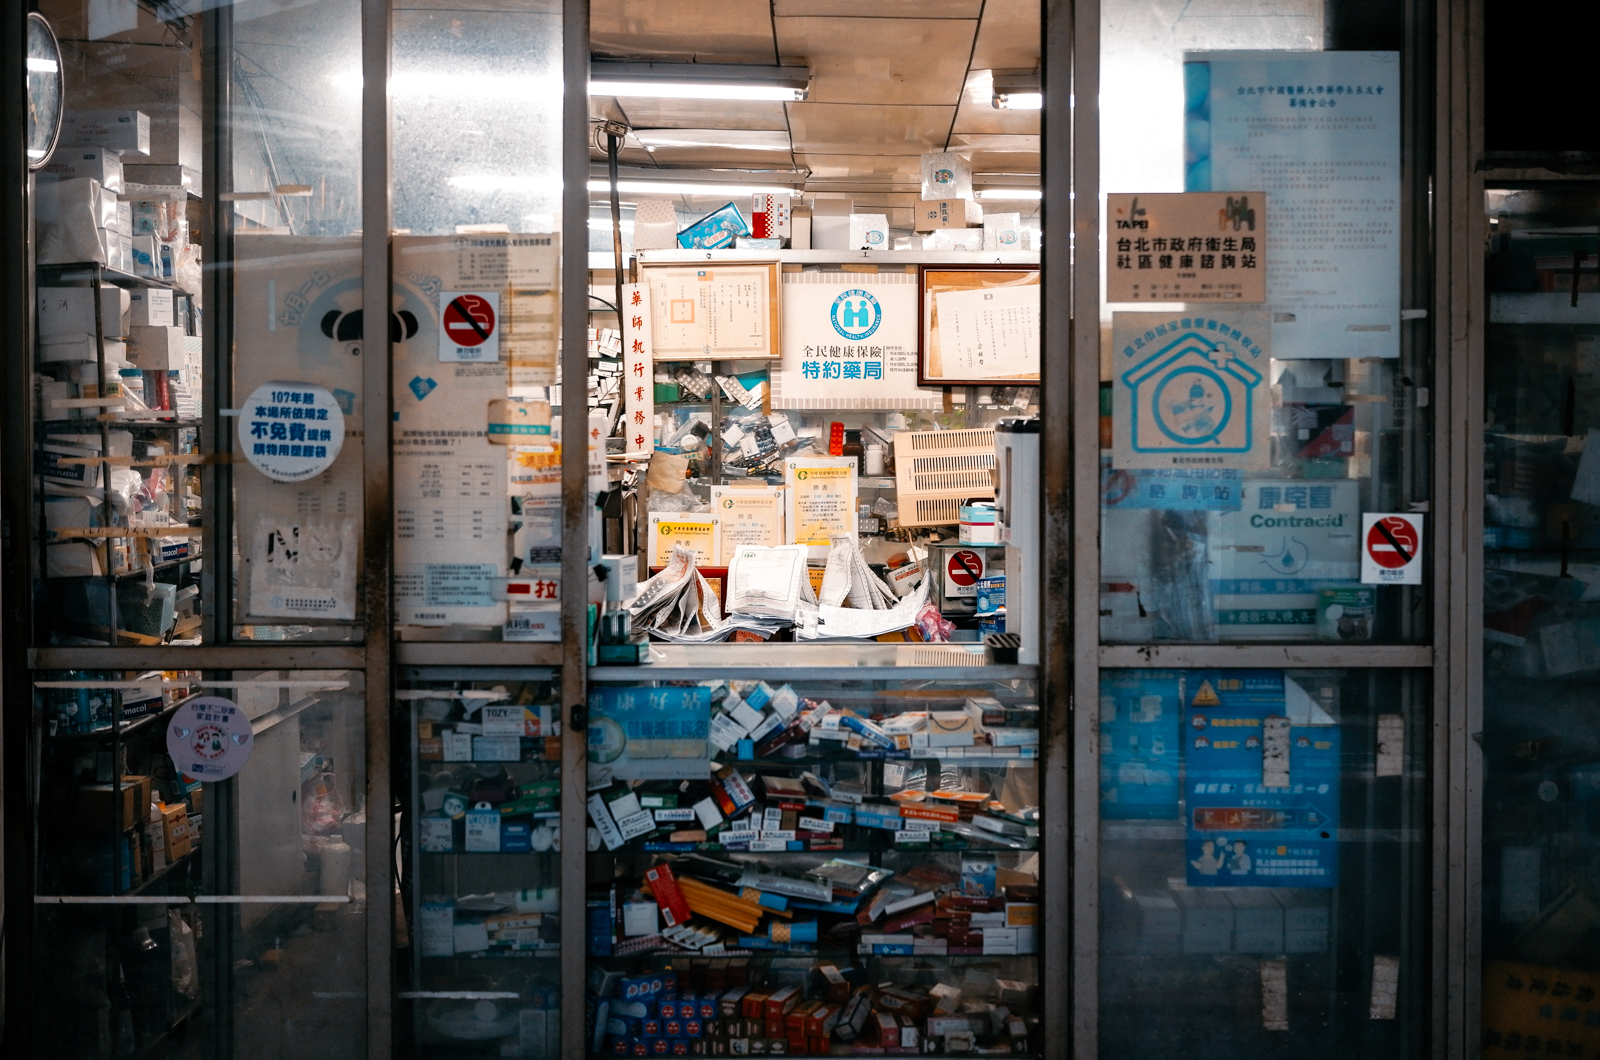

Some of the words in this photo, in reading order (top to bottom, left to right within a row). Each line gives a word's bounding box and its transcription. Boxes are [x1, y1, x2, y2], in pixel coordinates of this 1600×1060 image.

[1116, 236, 1256, 252] 台北市政府衛生局
[1116, 254, 1257, 269] 社區健康諮詢站
[802, 345, 882, 358] 全民健康保險
[631, 291, 646, 450] 藥師執行業務中
[801, 360, 882, 380] 特約藥局
[271, 391, 315, 405] 107年起
[255, 405, 329, 420] 本場所依規定
[250, 421, 332, 442] 不免費提供
[253, 443, 327, 458] 購物用塑膠袋
[1250, 513, 1344, 529] Contracid
[534, 579, 558, 599] 拉
[486, 708, 508, 717] TOZY
